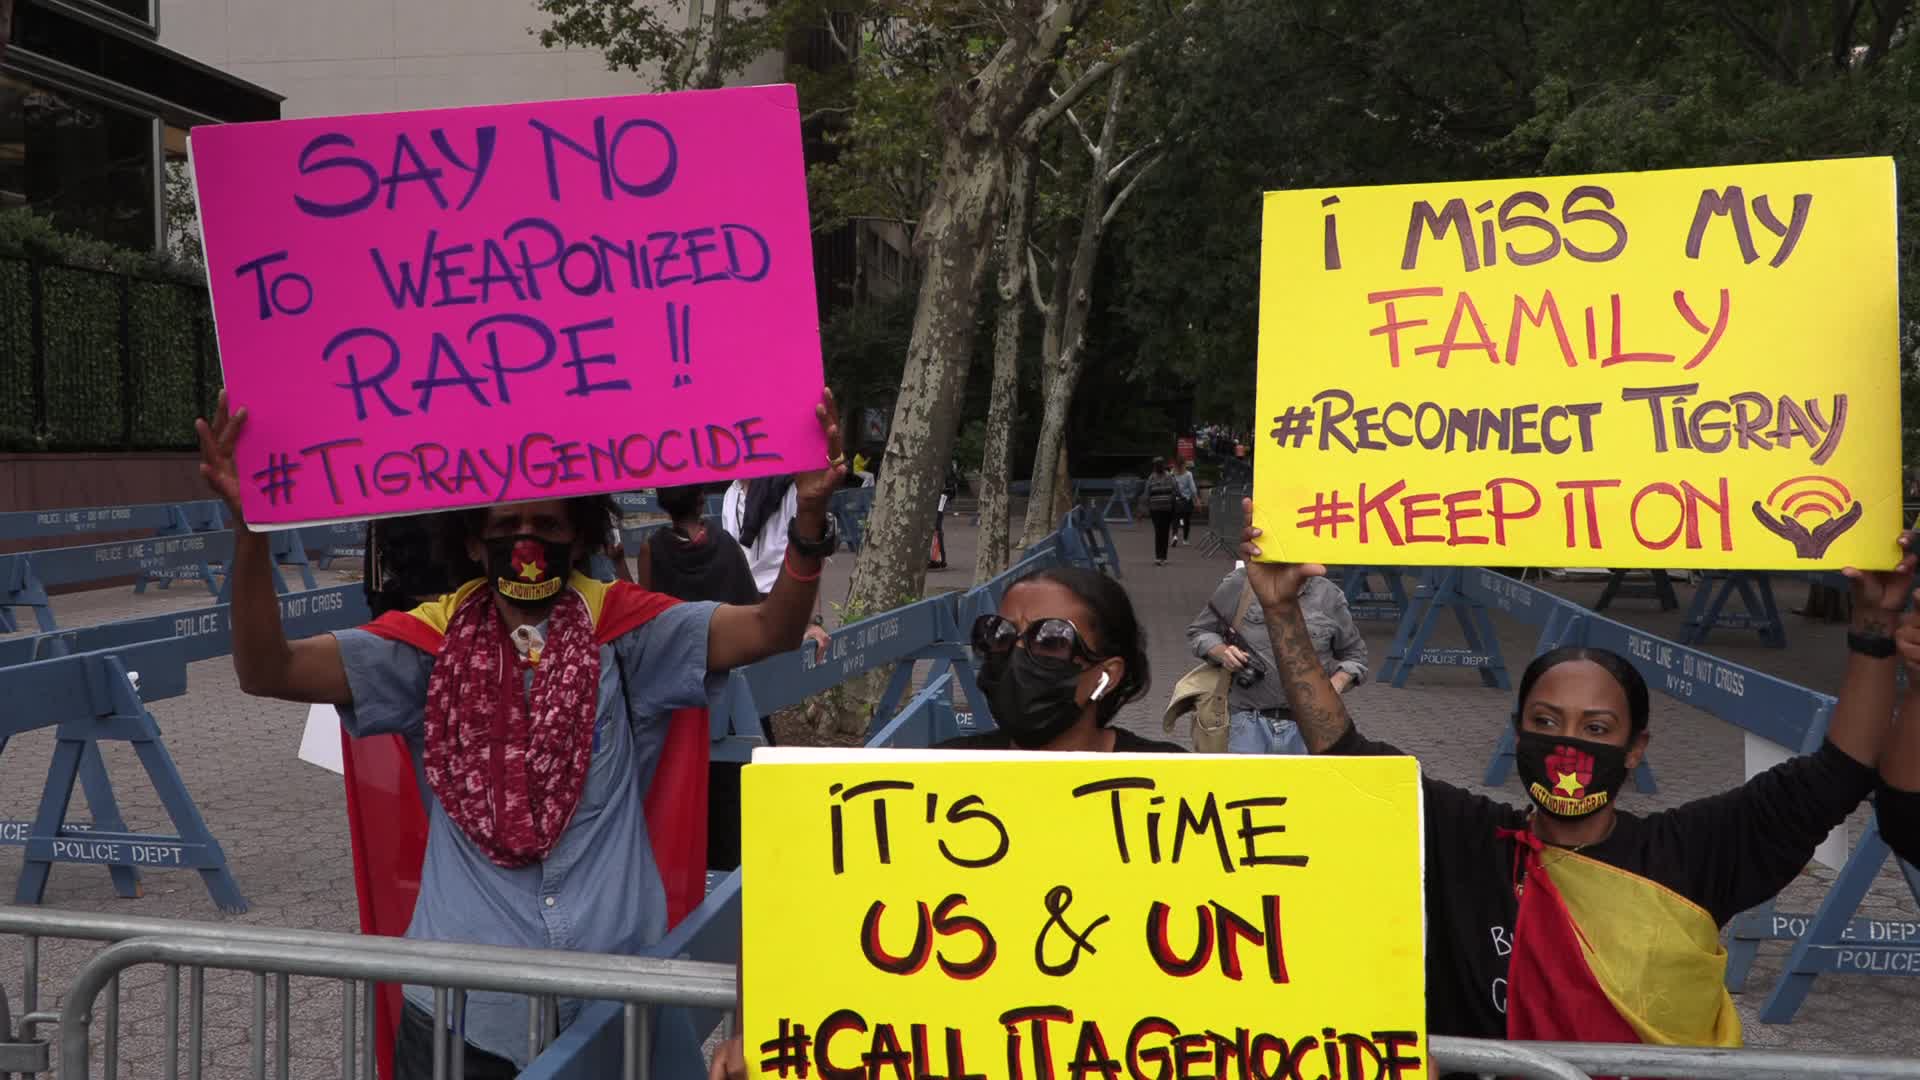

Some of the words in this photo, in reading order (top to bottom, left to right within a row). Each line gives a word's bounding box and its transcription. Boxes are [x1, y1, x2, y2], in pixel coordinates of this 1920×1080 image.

[293, 125, 498, 220] SAY
[527, 115, 680, 203] NO
[1685, 185, 1814, 269] MY
[234, 249, 315, 322] TO
[369, 217, 772, 309] WEAPONIZED
[1367, 286, 1731, 372] FAMILY
[322, 312, 633, 422] RAPE
[1269, 388, 1604, 455] #RECONNECT
[175, 612, 218, 638] POLICE
[288, 598, 307, 618] NOT
[311, 591, 344, 614] CROSS
[1420, 654, 1457, 666] POLICE
[1461, 655, 1489, 666] DEPT
[1628, 634, 1651, 661] POLICE
[1656, 644, 1672, 669] LINE
[1683, 654, 1694, 677] DO
[1696, 660, 1713, 685] NOT
[1715, 666, 1744, 697] CROSS
[1666, 674, 1693, 697] NYPD
[52, 841, 121, 861] POLICE
[131, 845, 182, 863] DEPT
[860, 893, 999, 983] US
[1034, 885, 1112, 978] &
[1145, 894, 1291, 986] UN
[1837, 950, 1920, 972] POLICE
[1869, 920, 1920, 941] DEP
